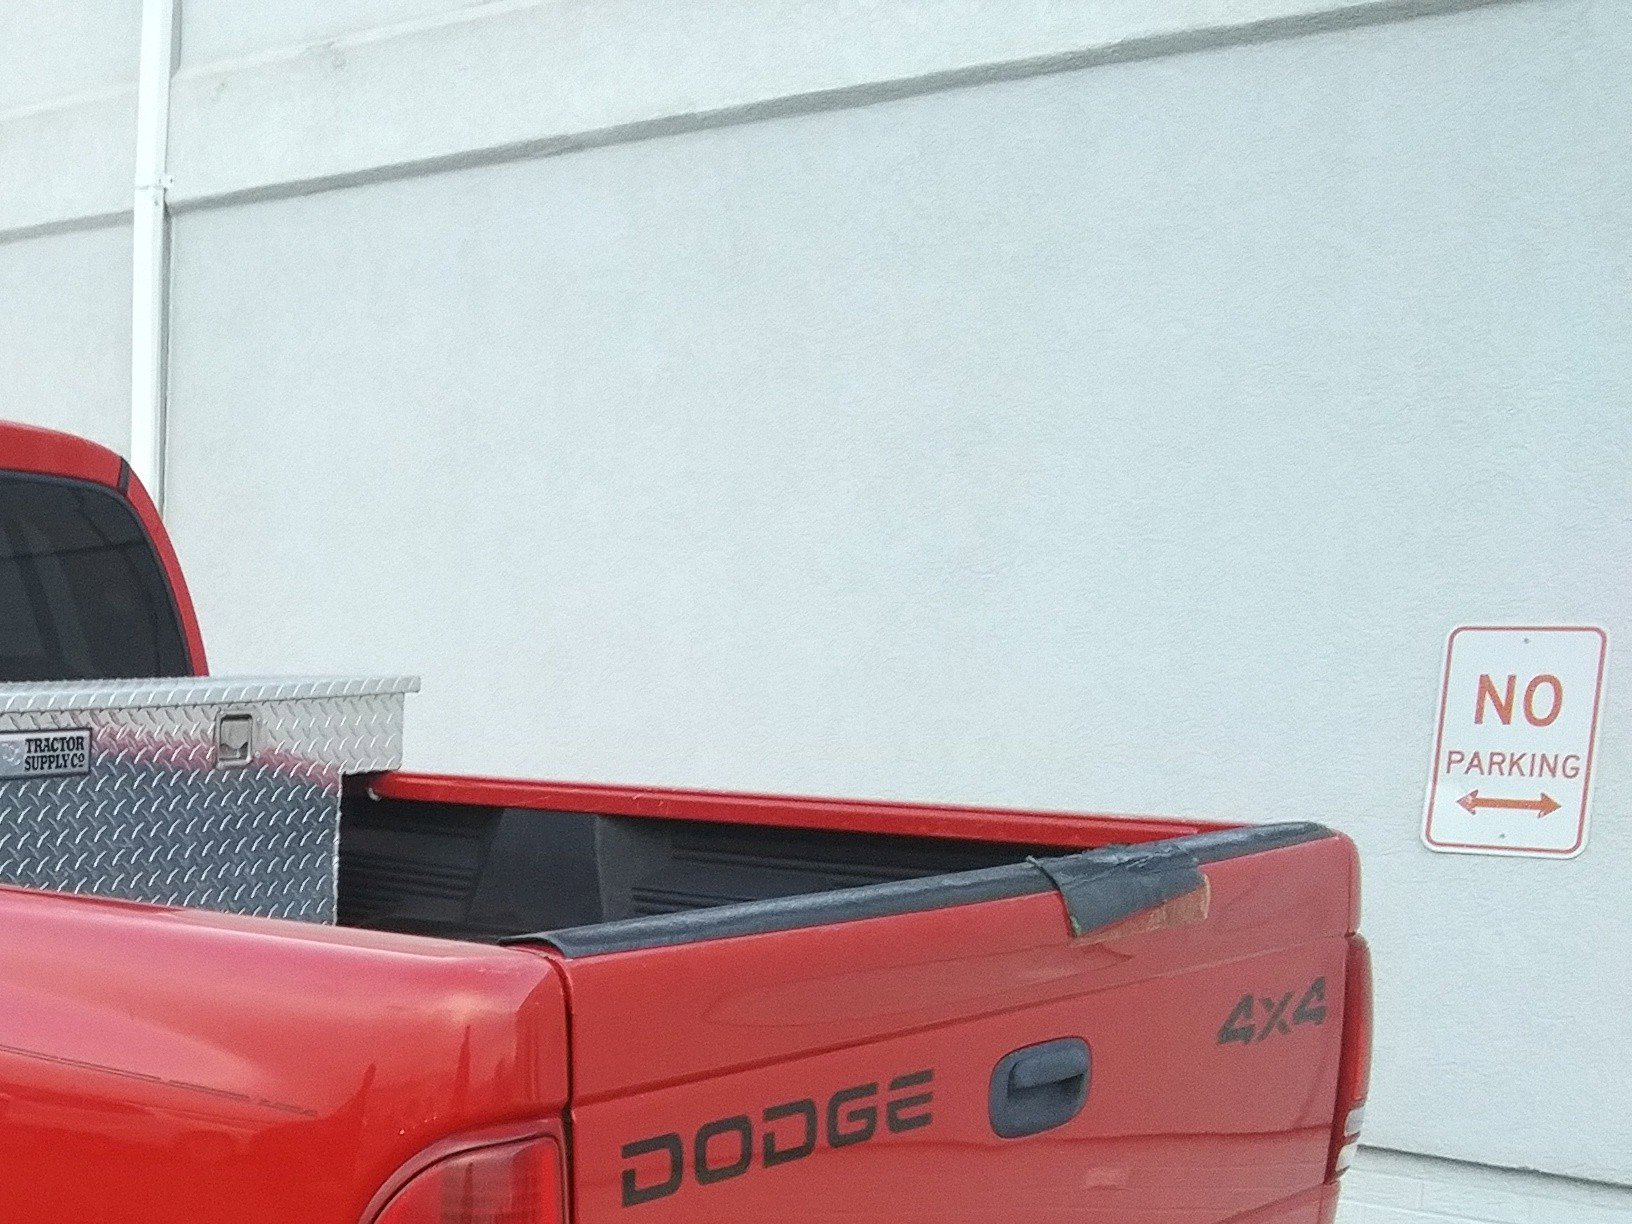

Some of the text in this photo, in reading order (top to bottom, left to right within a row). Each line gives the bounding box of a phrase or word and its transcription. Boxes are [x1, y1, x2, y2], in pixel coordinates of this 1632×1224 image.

[1473, 674, 1564, 727] NO
[24, 736, 85, 754] TRACTOR
[24, 754, 70, 772] SUPPLY
[1446, 751, 1581, 779] PARKING
[621, 1069, 935, 1208] DODGE
